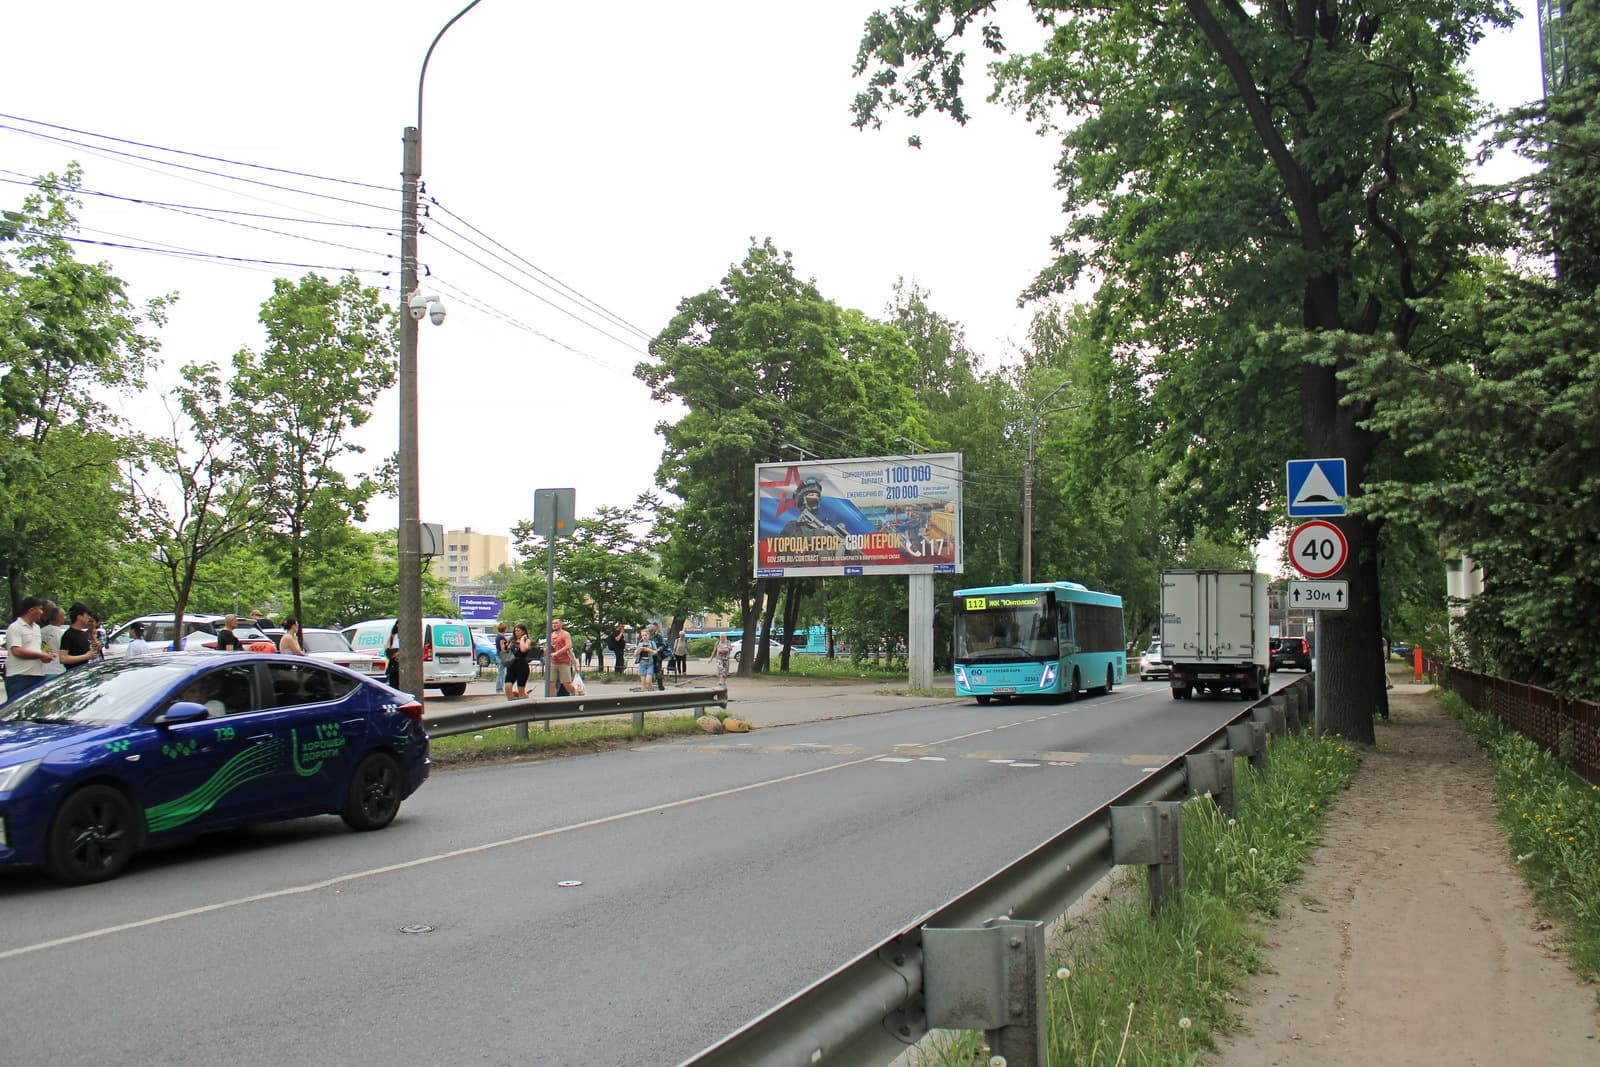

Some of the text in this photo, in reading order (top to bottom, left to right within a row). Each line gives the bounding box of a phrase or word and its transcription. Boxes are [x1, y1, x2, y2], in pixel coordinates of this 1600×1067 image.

[911, 465, 931, 482] 000
[886, 486, 901, 500] 210
[902, 485, 919, 499] 000
[767, 533, 902, 554] У ГОРОДА-ГЕРОЯ СВОИ ГЕРОИ
[920, 538, 944, 557] 117
[1302, 538, 1335, 561] 40
[1305, 589, 1331, 601] 30м
[968, 599, 984, 609] 112
